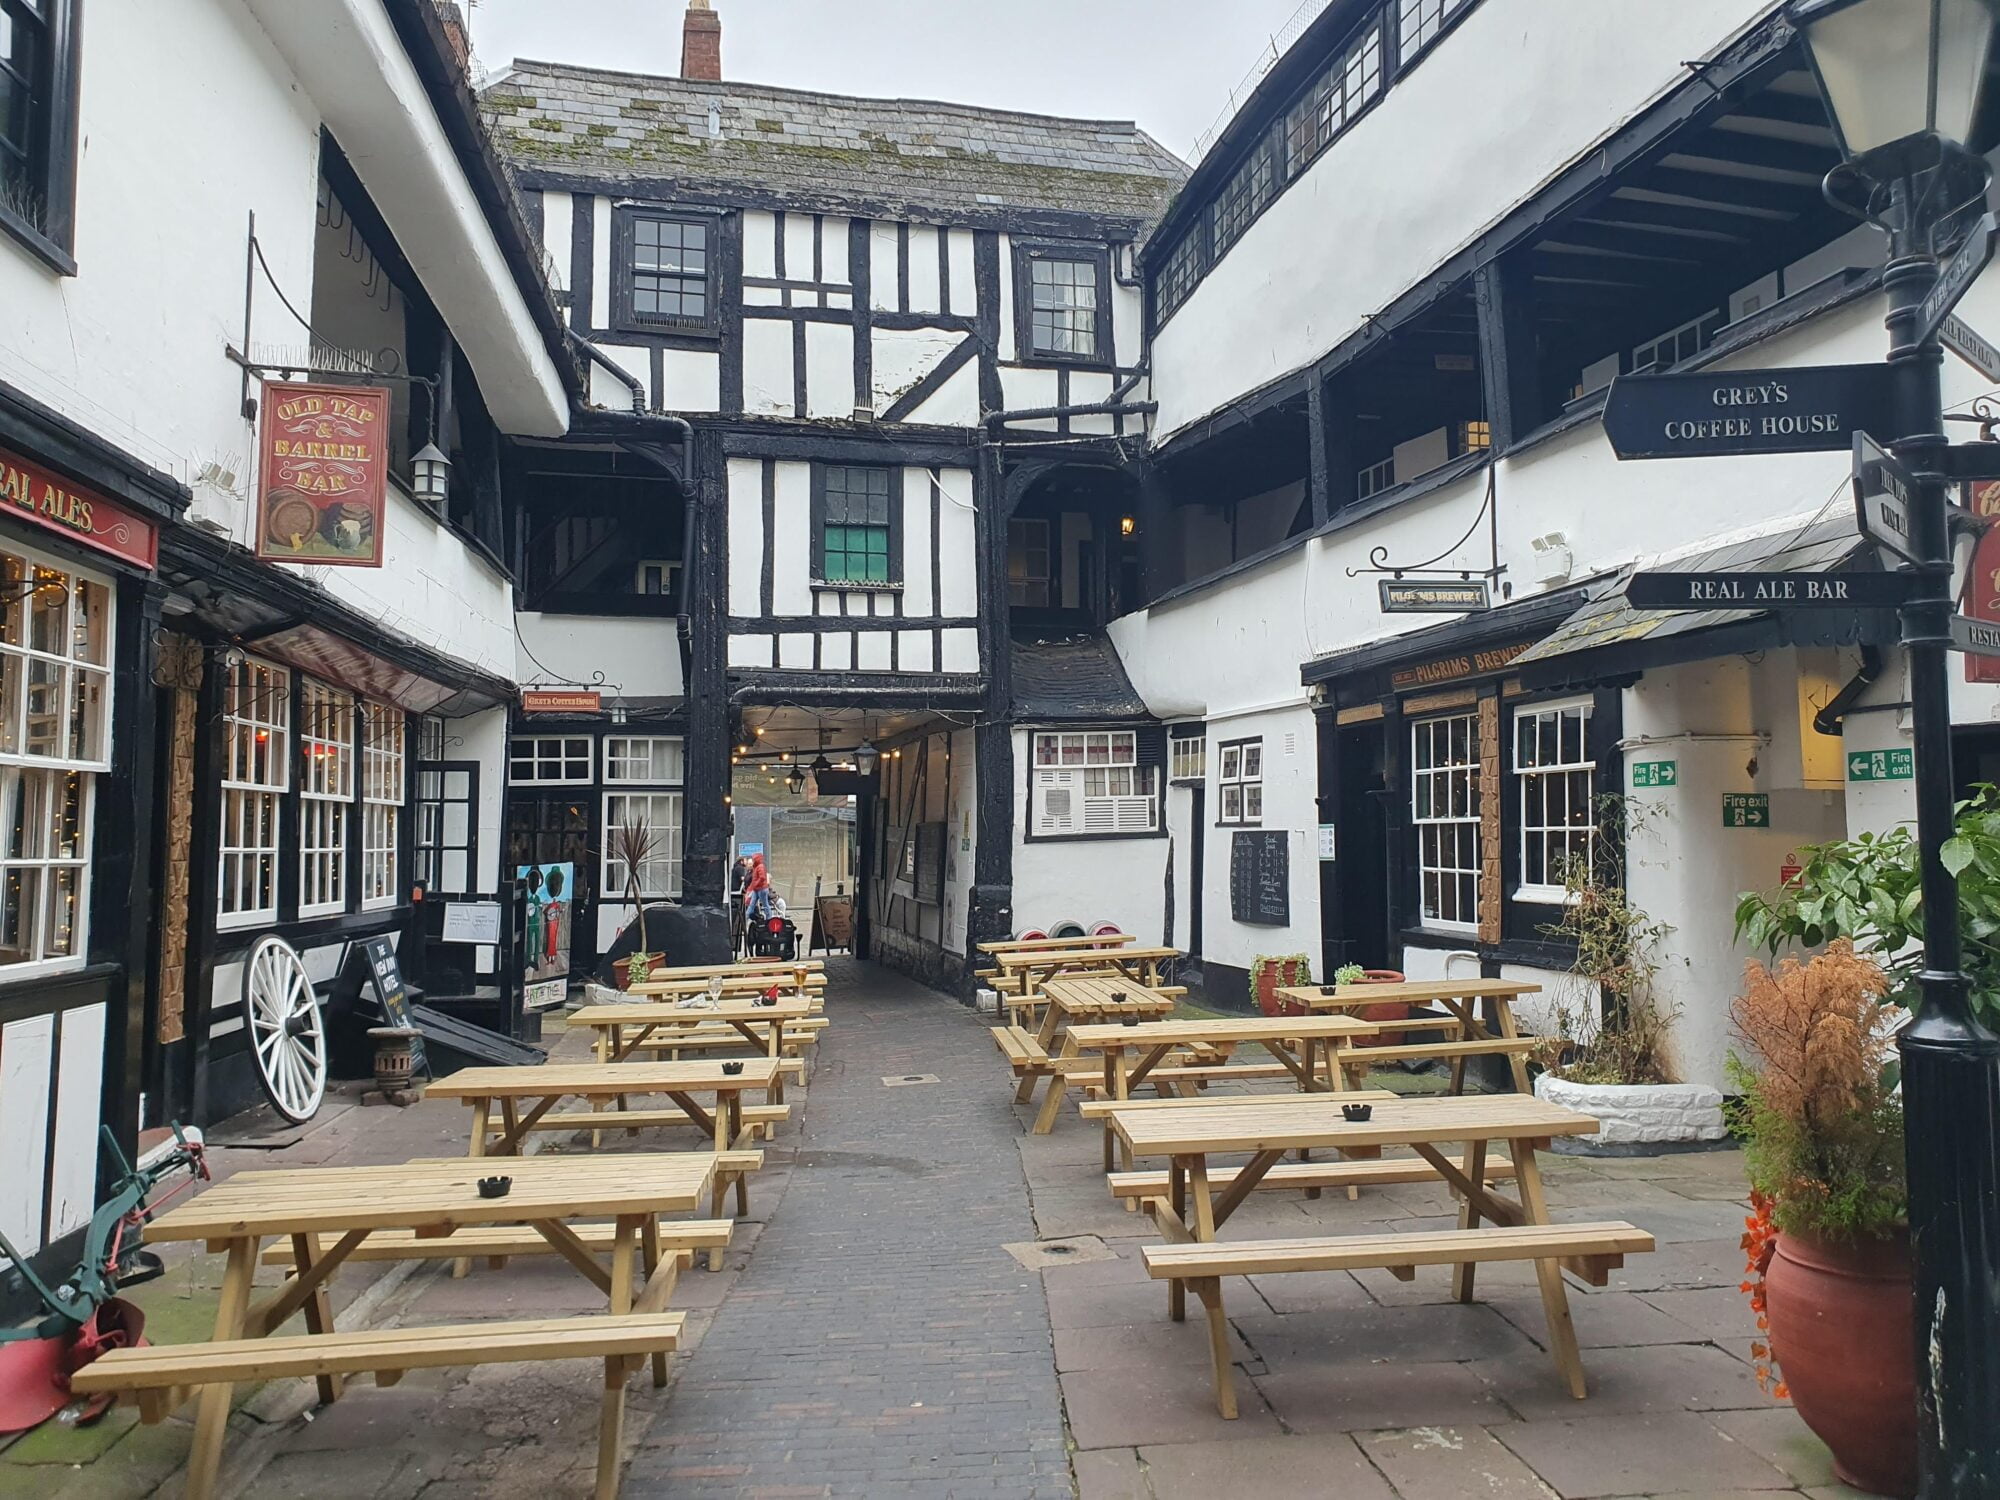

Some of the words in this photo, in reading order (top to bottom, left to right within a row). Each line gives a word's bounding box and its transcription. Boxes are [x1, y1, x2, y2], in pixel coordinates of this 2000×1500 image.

[1712, 381, 1789, 407] GREY'S
[277, 398, 324, 421] OLD
[331, 399, 376, 425] TAP
[315, 422, 335, 439] &
[1664, 420, 1752, 440] COFFEE
[1761, 414, 1840, 436] HOUSE
[274, 439, 372, 462] BARREL
[294, 471, 348, 491] BAR
[40, 484, 94, 534] ALES
[1689, 581, 1745, 600] REAL
[1754, 581, 1796, 599] ALE
[1807, 580, 1849, 599] BAR
[1415, 656, 1471, 682] PILGRIMS
[1891, 752, 1911, 764] Fire
[1634, 766, 1646, 775] Fire
[1892, 764, 1911, 776] exit
[1634, 776, 1646, 785] exit
[1723, 795, 1747, 807] Fire
[1748, 795, 1768, 807] exit
